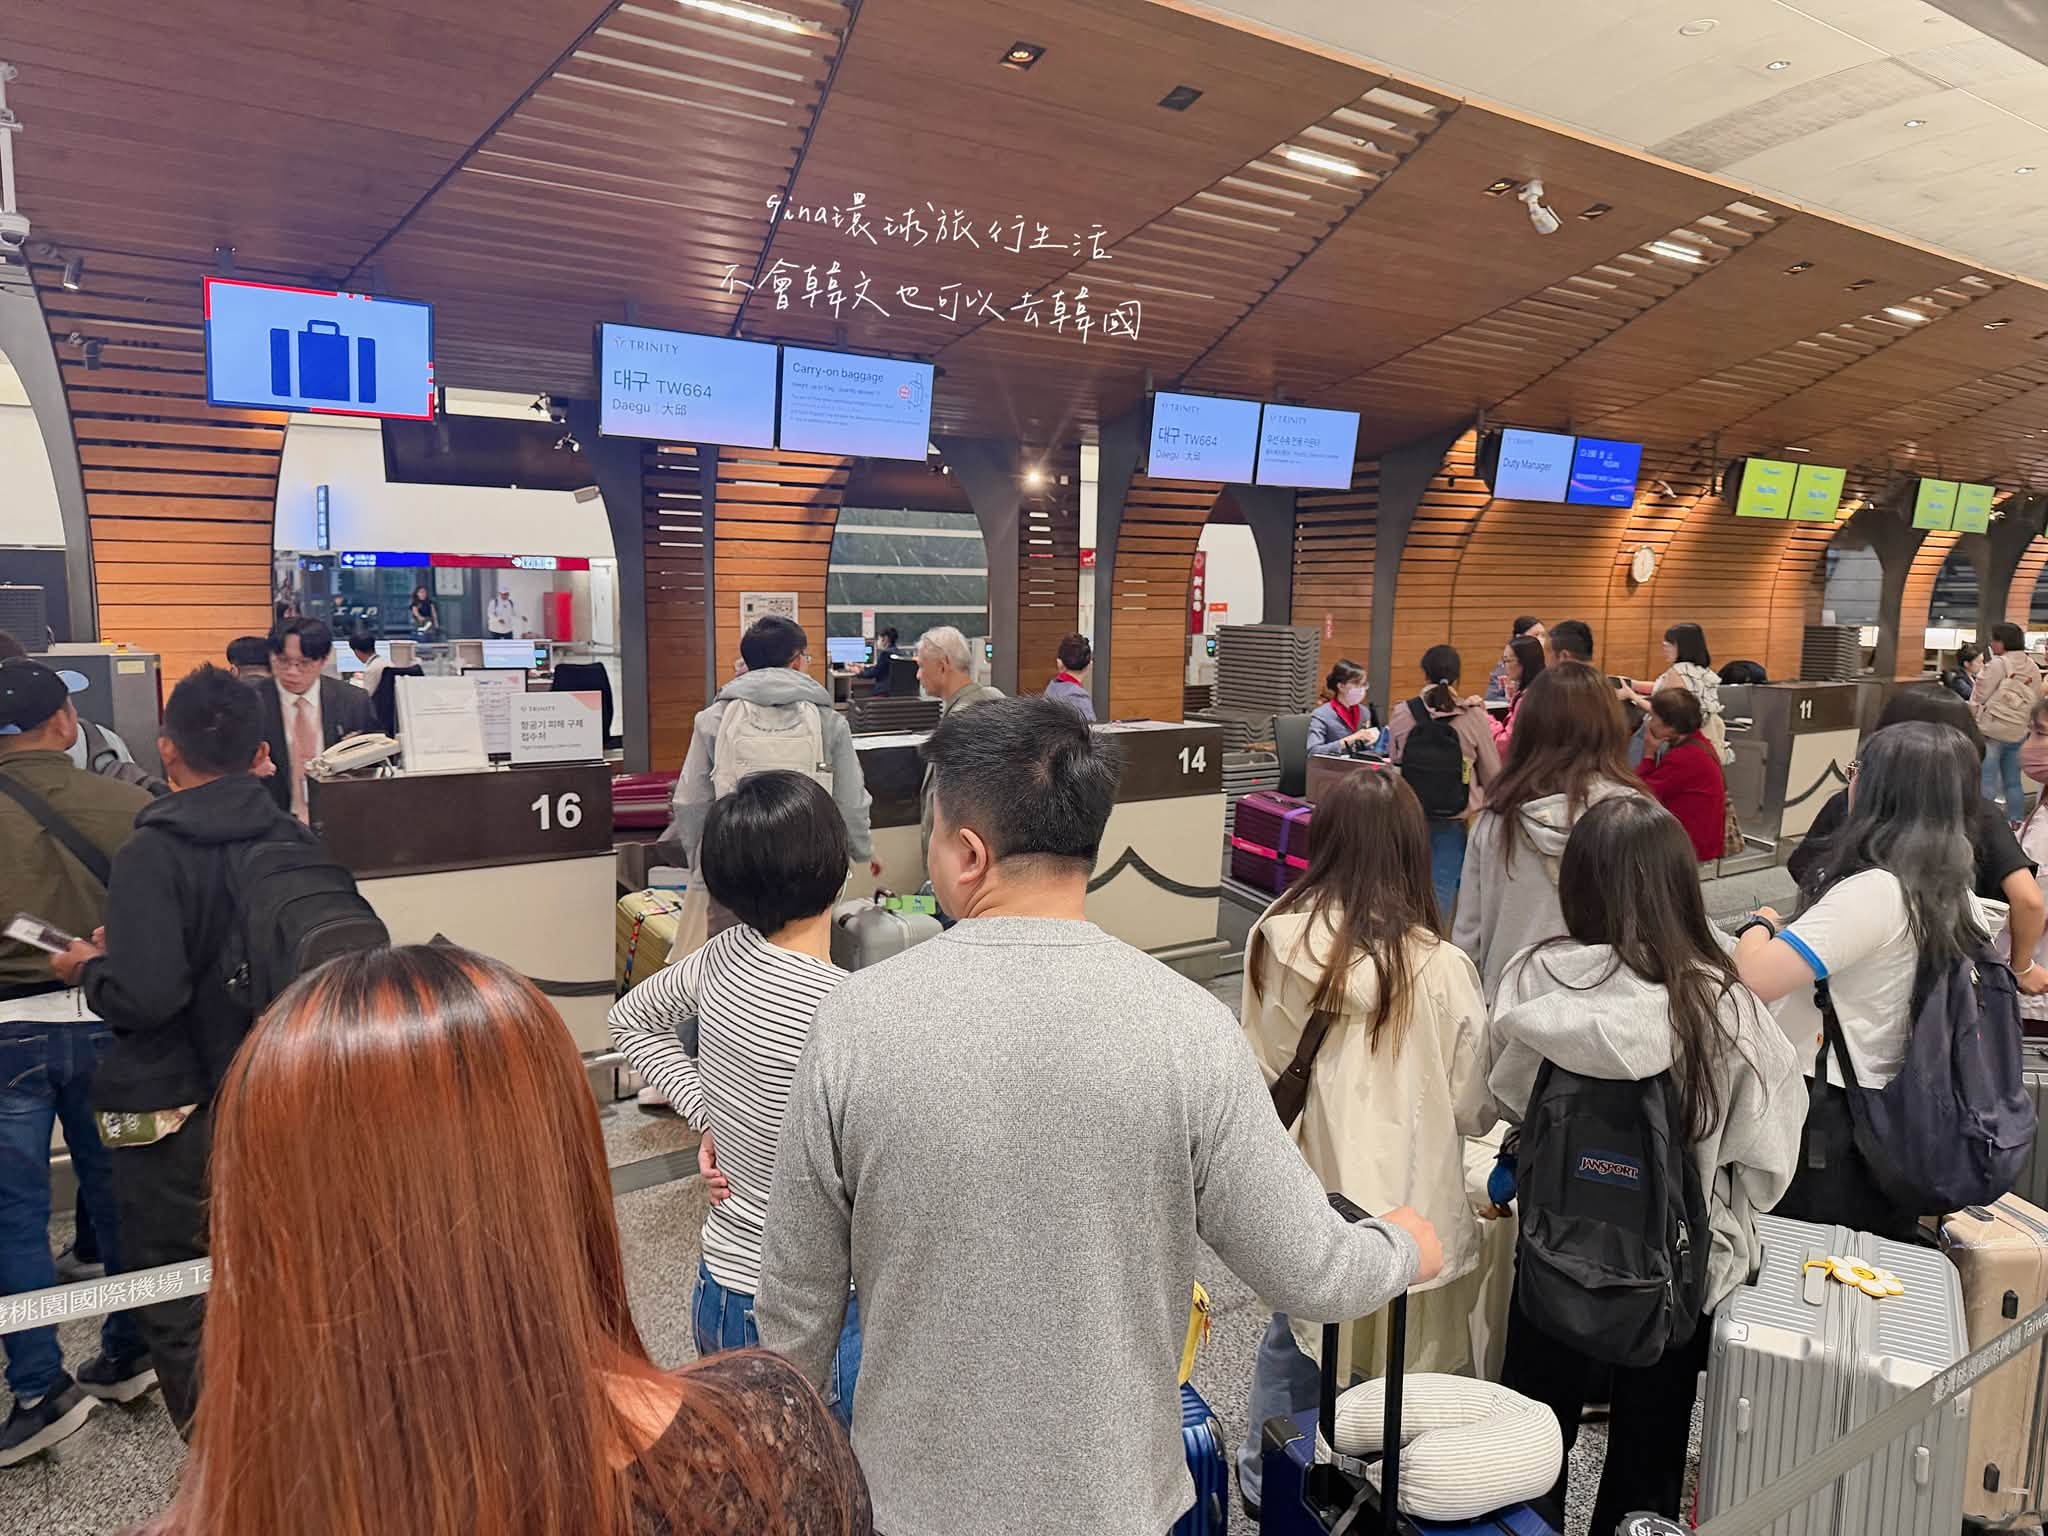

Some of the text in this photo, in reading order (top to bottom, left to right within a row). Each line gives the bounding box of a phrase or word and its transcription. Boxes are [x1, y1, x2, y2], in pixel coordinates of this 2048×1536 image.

[629, 339, 679, 354] TRINITY
[792, 362, 884, 384] Carry-on baggage
[614, 368, 712, 400] 대구 TW664
[612, 398, 650, 414] Daegu
[1158, 425, 1180, 445] 대구
[1503, 457, 1552, 473] Duty Manager
[1799, 699, 1812, 719] 11
[1178, 745, 1207, 774] 14
[531, 792, 582, 830] 16
[1579, 1156, 1639, 1179] JANSPORT
